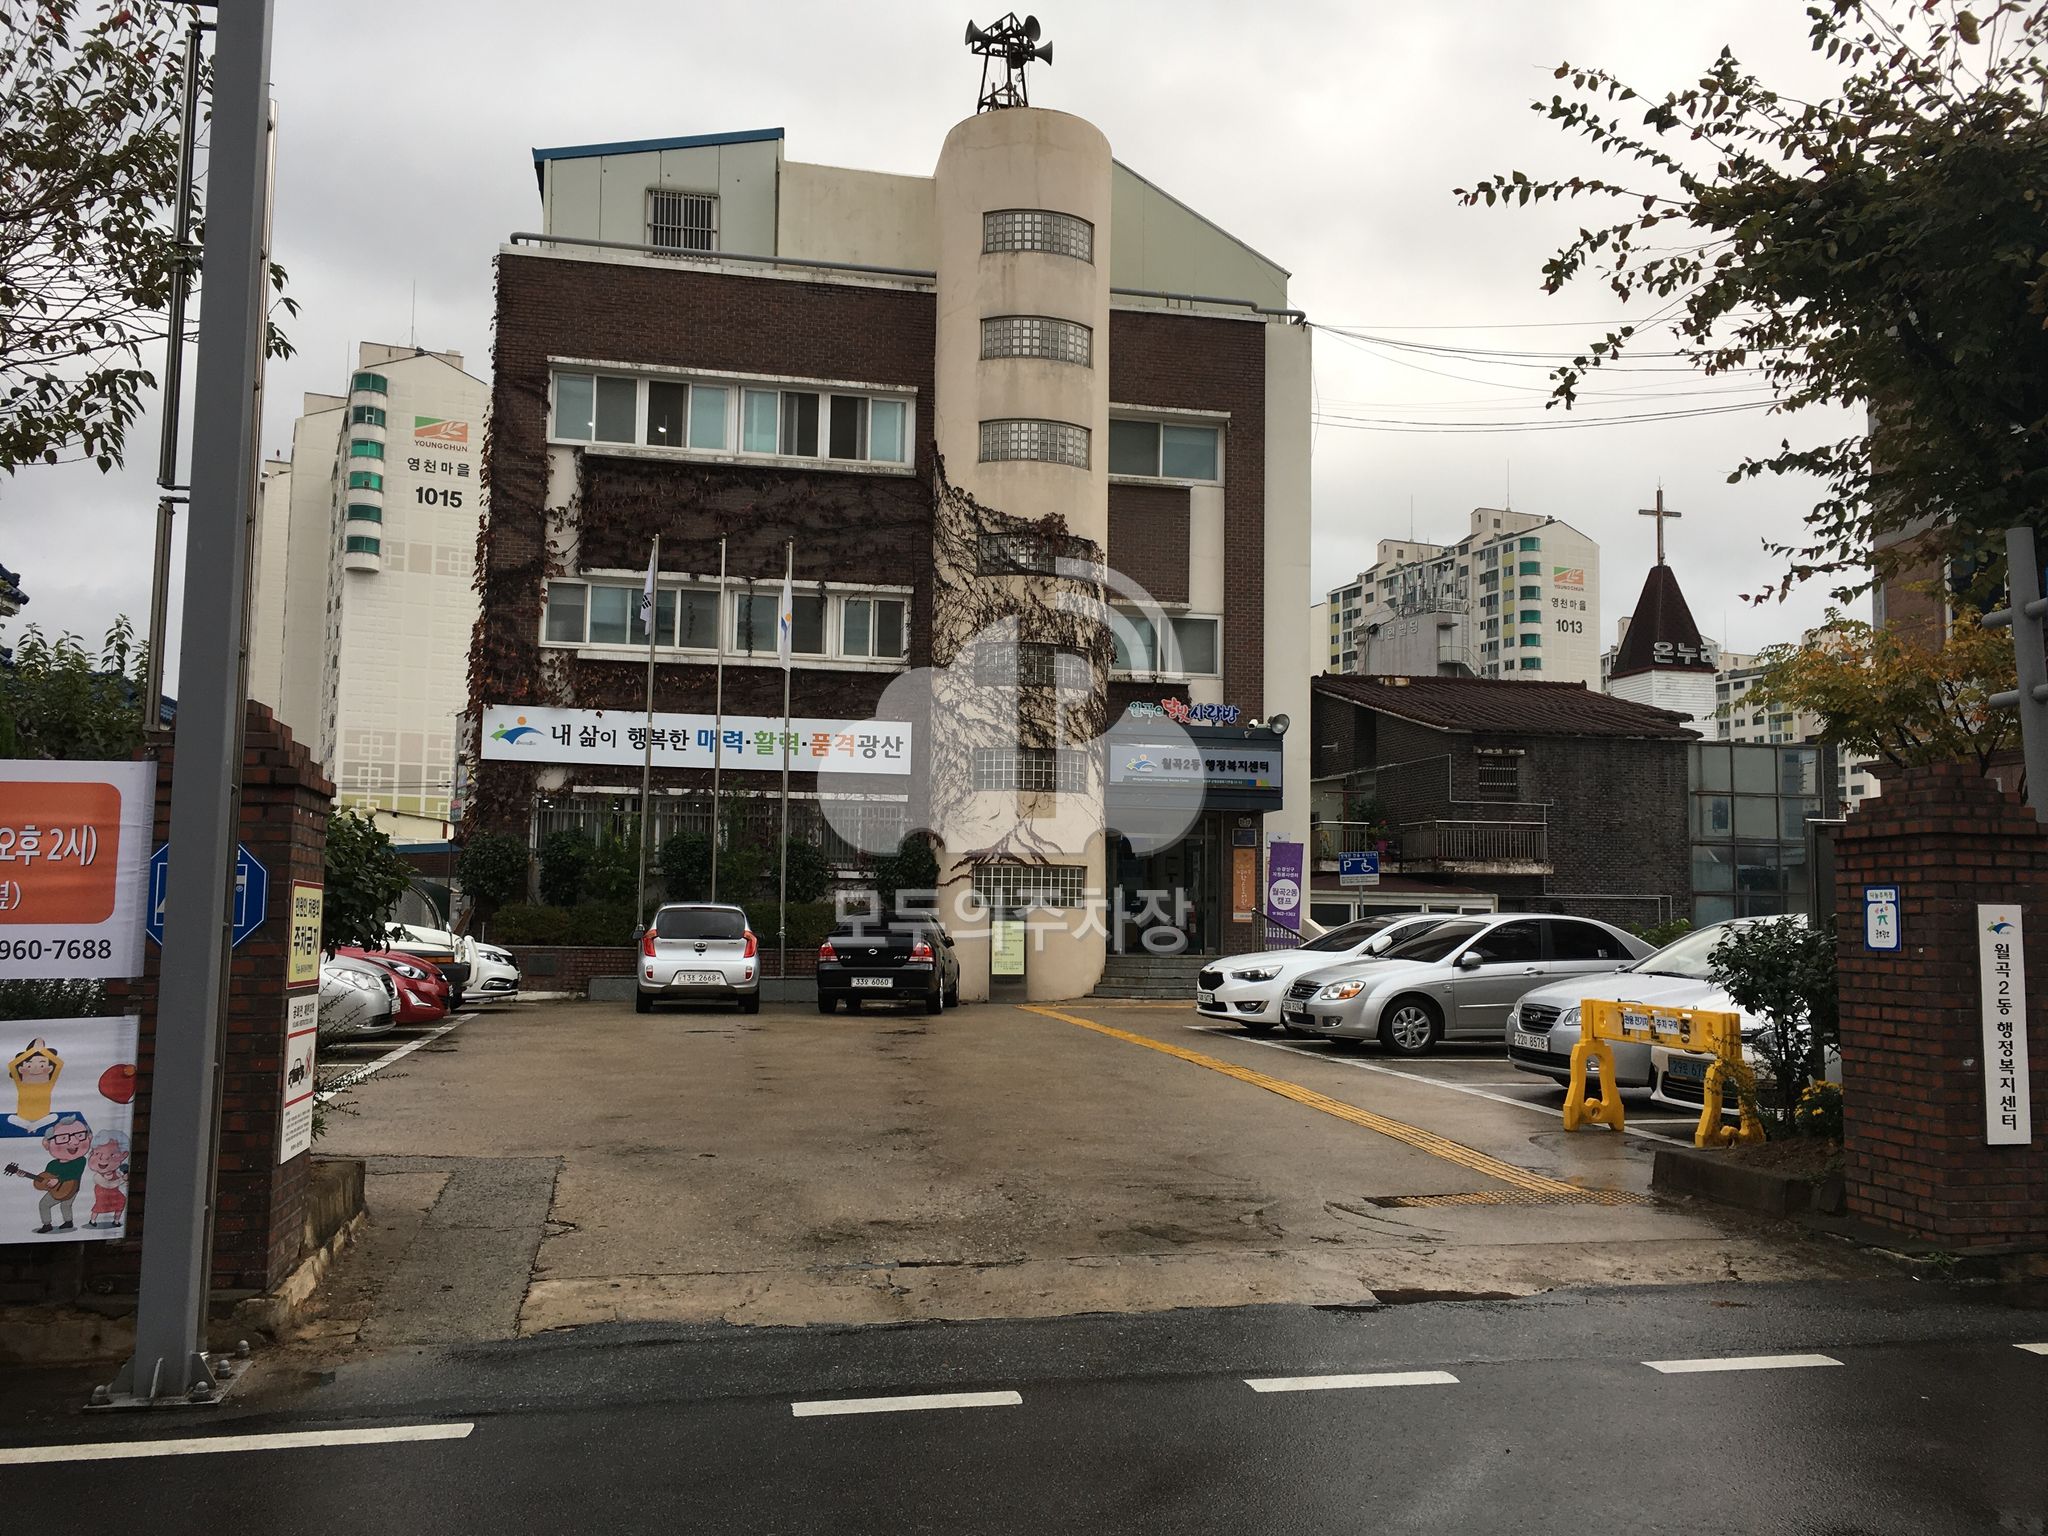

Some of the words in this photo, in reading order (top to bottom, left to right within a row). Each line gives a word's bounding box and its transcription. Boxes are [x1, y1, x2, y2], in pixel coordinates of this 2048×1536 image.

[414, 439, 468, 452] YOUNGCHUN
[407, 457, 470, 478] 영천마을
[415, 486, 463, 508] 1015
[1551, 597, 1586, 611] 영천마을
[1555, 618, 1583, 634] 1013
[1653, 641, 1719, 668] 온누리
[551, 724, 571, 746] 내
[579, 725, 617, 748] 삶이
[627, 727, 690, 751] 행복한
[1161, 757, 1201, 771] 월곡2동
[1205, 759, 1269, 773] 행정복지센터
[0, 825, 41, 866] 오후
[47, 825, 98, 866] 2시)
[1343, 860, 1352, 871] P
[1272, 887, 1297, 897] 월곡2동
[1277, 897, 1292, 905] 캠프
[293, 925, 319, 956] 주차금지
[871, 978, 889, 986] 6060
[1994, 943, 2012, 1016] 월곡2동
[1656, 1018, 1667, 1029] 주차
[1530, 1036, 1545, 1049] 8578
[1997, 1021, 2017, 1131] 행정복지센터
